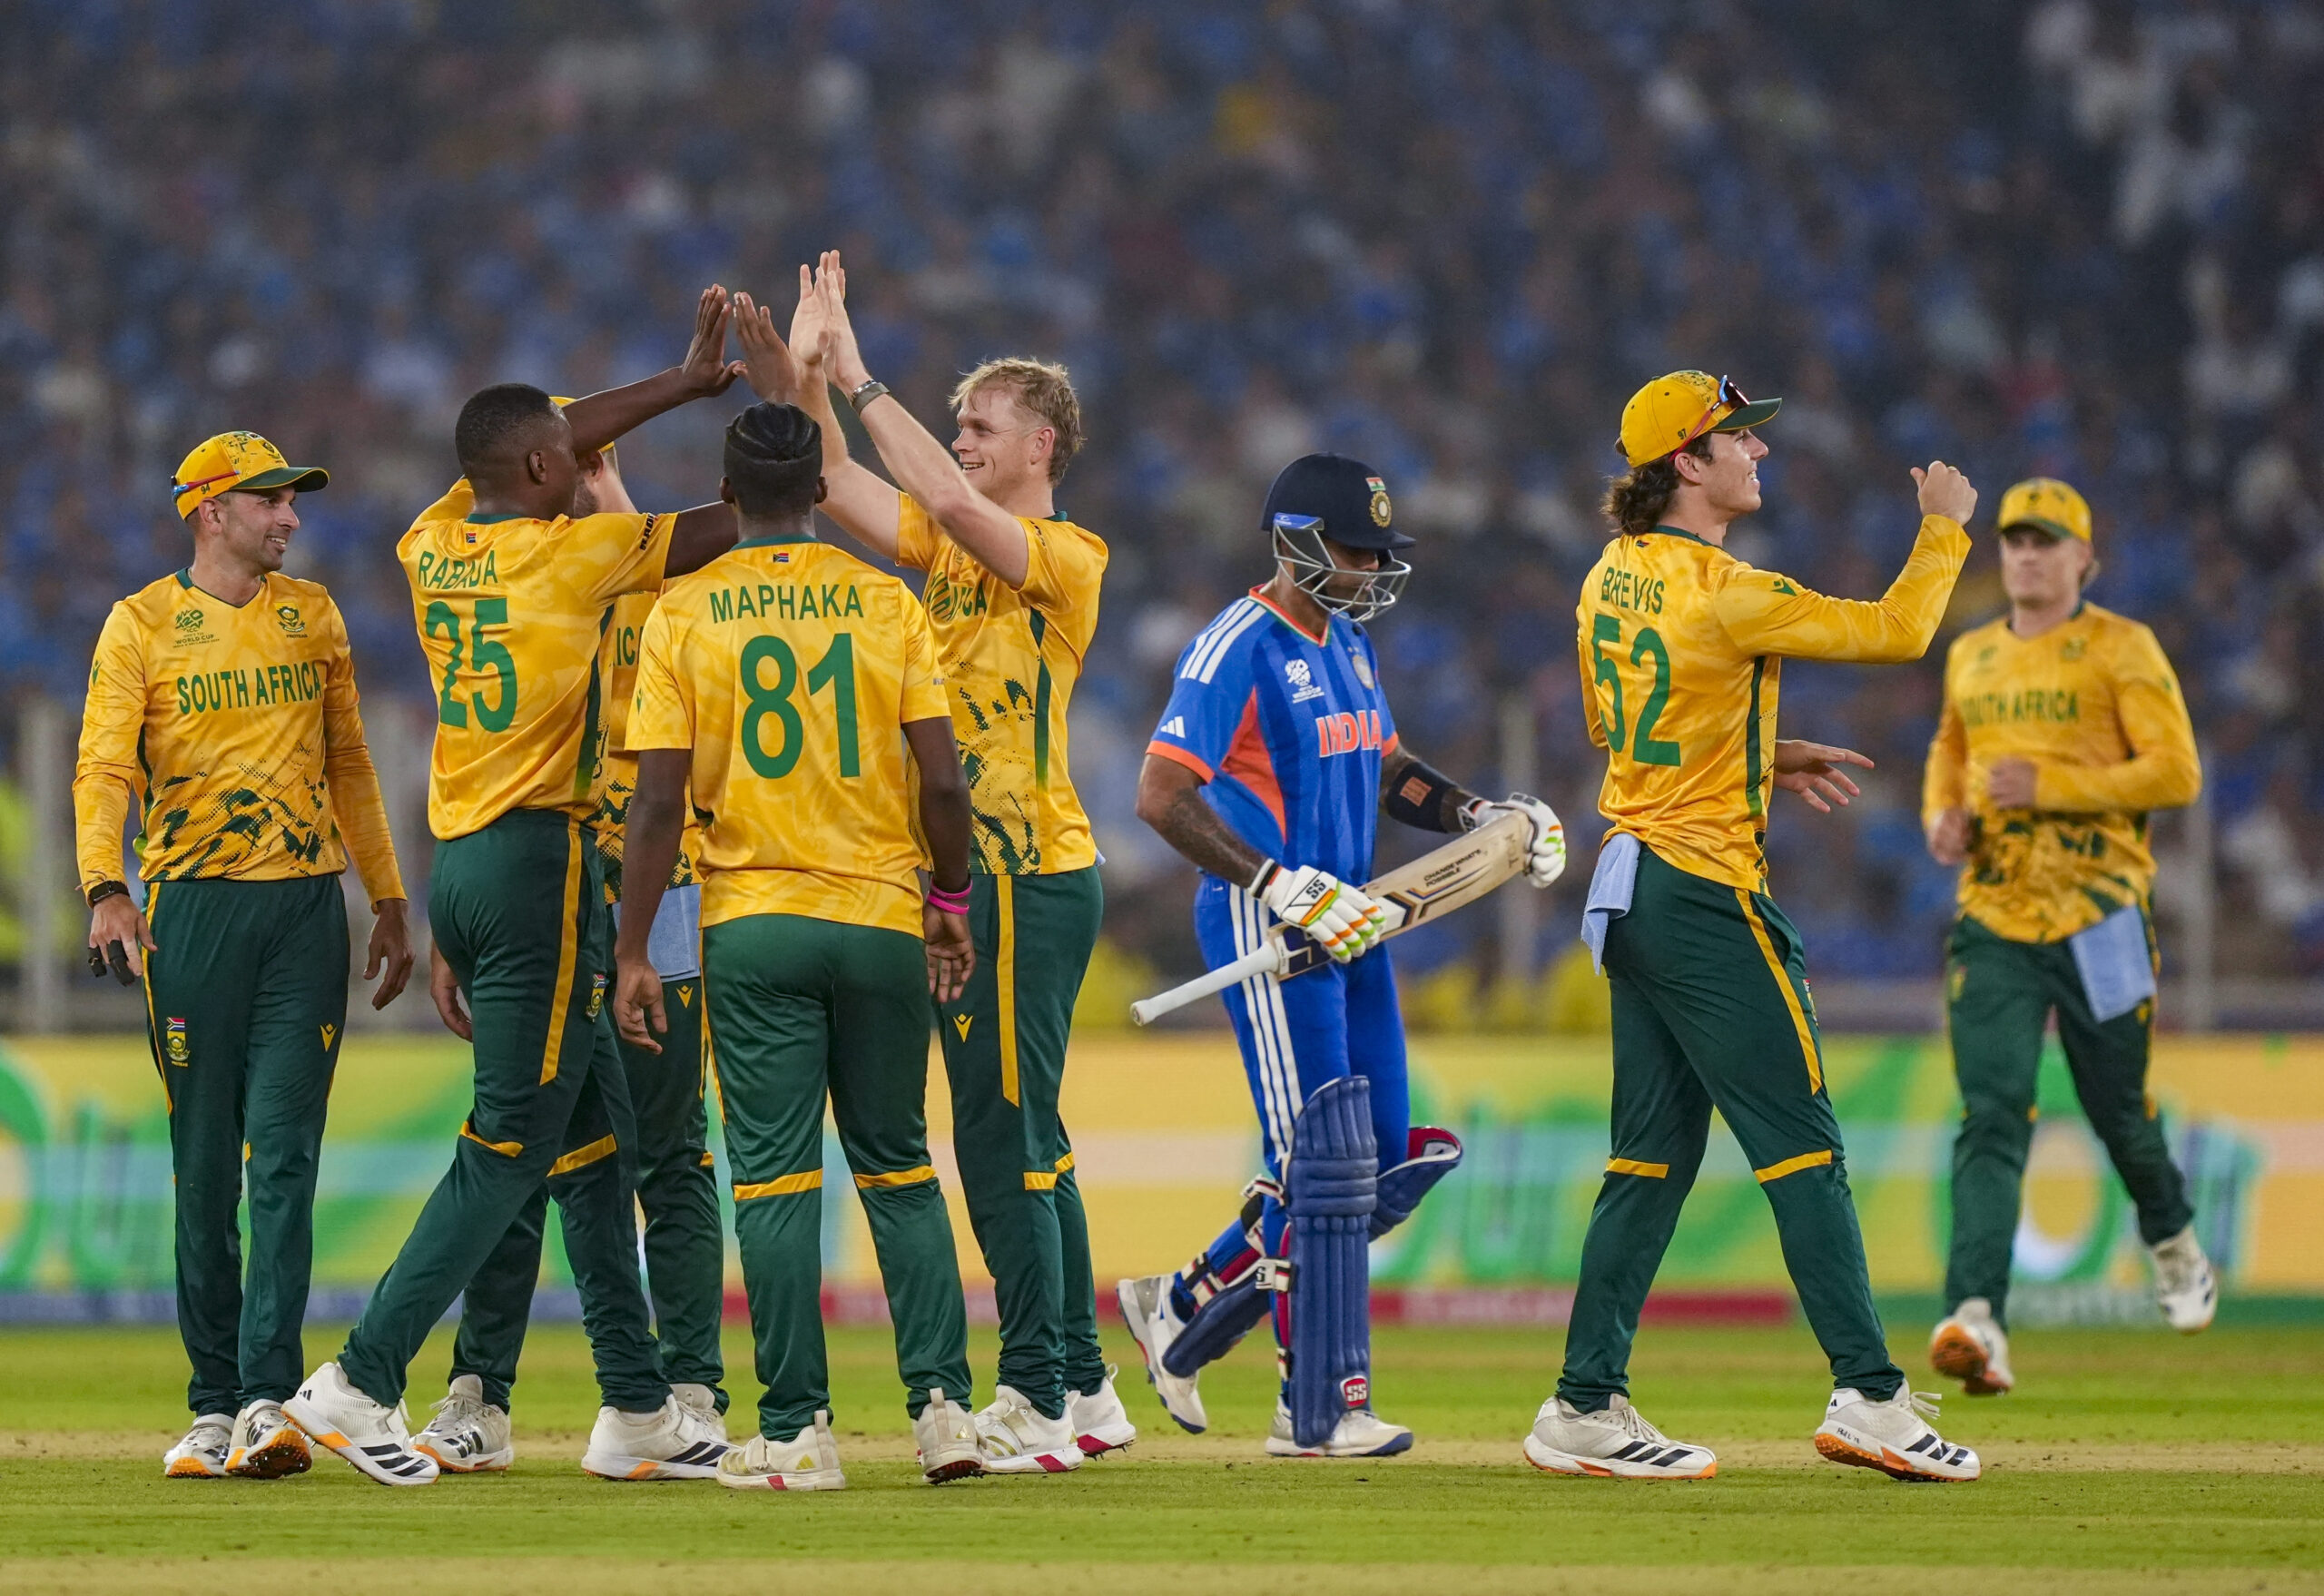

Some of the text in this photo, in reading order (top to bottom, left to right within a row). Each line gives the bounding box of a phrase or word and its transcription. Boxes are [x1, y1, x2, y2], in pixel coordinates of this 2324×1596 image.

[1678, 428, 1687, 440] 97
[201, 482, 210, 495] 94
[709, 584, 864, 624] MAPHAKA
[1600, 566, 1665, 615] BREVIS
[175, 636, 201, 645] WORLD
[425, 597, 518, 734] 25
[177, 661, 322, 714] SOUTH AFRICA
[740, 633, 861, 780] 81
[1591, 613, 1681, 767] 52
[2013, 688, 2079, 724] AFRICA
[1315, 710, 1383, 758] INDIA
[1305, 879, 1326, 900] SS
[1346, 1384, 1367, 1402] SS
